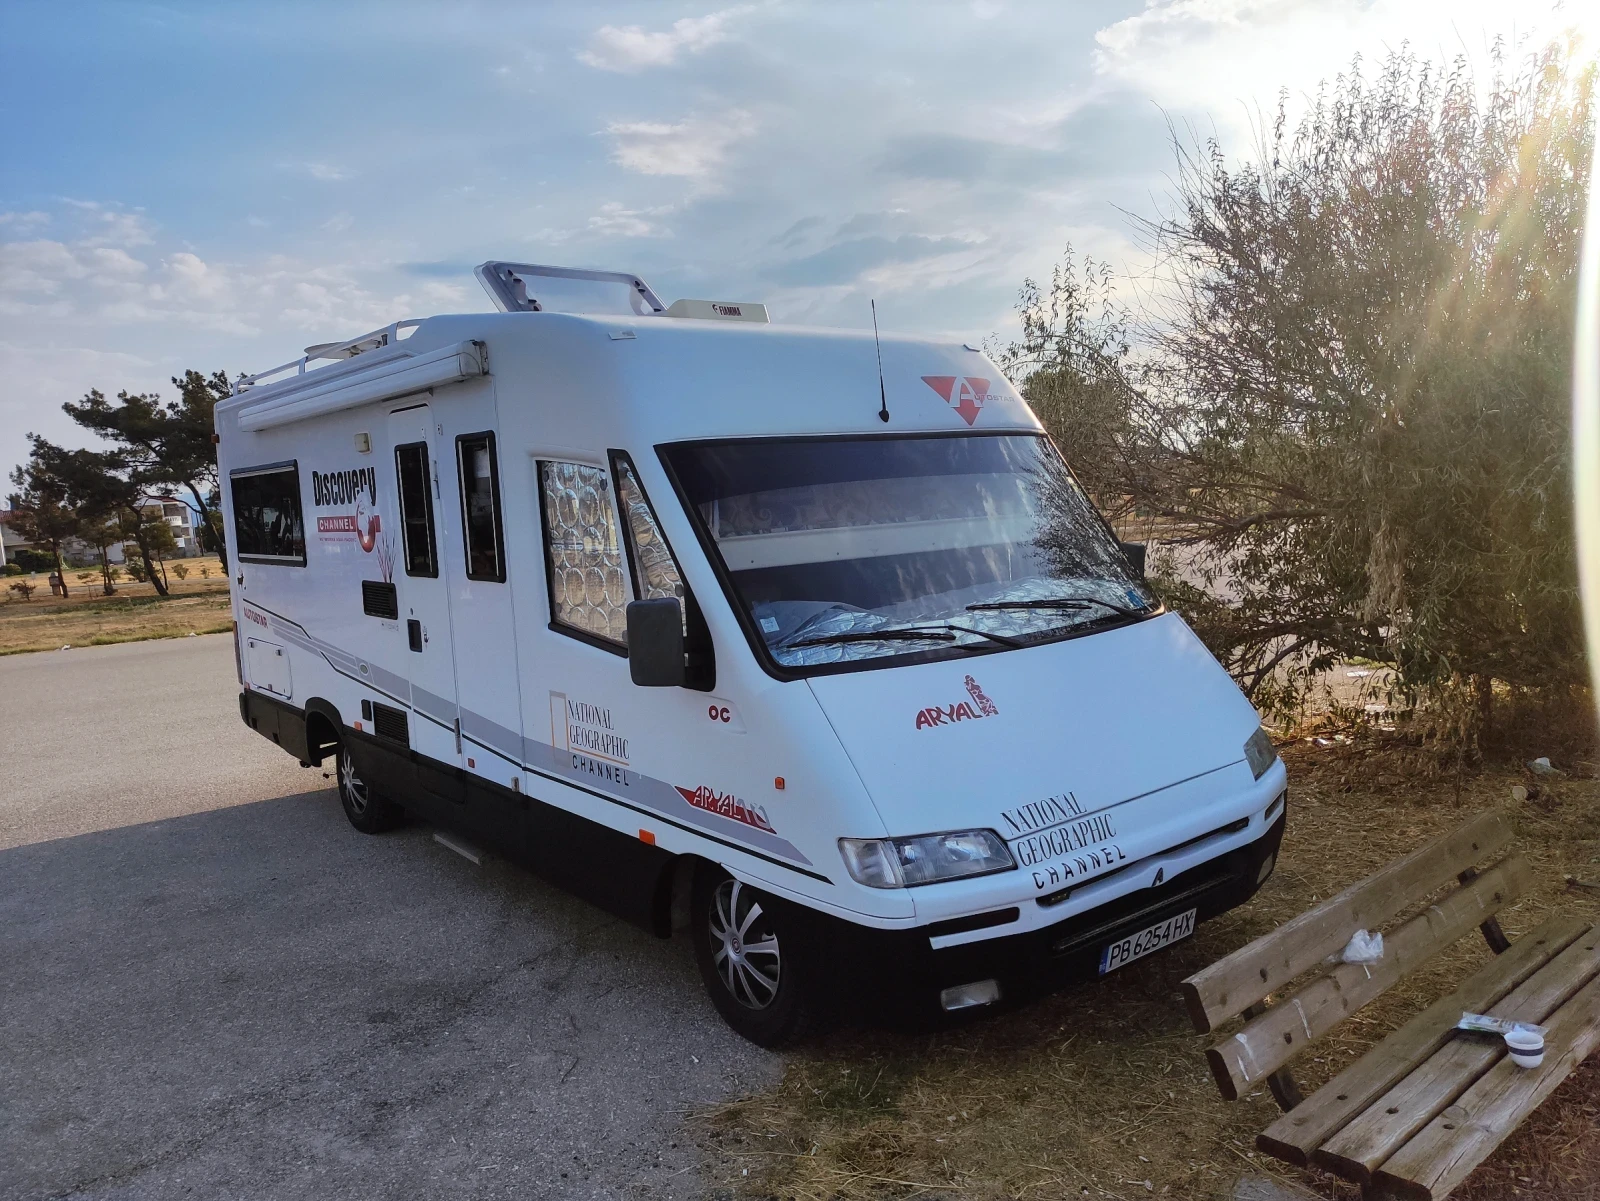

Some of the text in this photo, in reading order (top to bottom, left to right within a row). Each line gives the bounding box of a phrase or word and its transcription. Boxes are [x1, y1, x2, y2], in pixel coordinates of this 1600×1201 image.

[319, 518, 354, 530] CHANNEL
[568, 699, 615, 731] NATIONAL
[708, 705, 731, 723] OC
[916, 701, 983, 730] ARYAL
[569, 724, 630, 760] GEOGRAPHIC
[572, 754, 630, 787] CHANNEL
[1000, 791, 1087, 835] NATIONAL
[1016, 813, 1117, 868] GEOGRAPHIC
[1031, 844, 1126, 889] CHANNEL
[1109, 911, 1194, 968] PB 6254 HX
